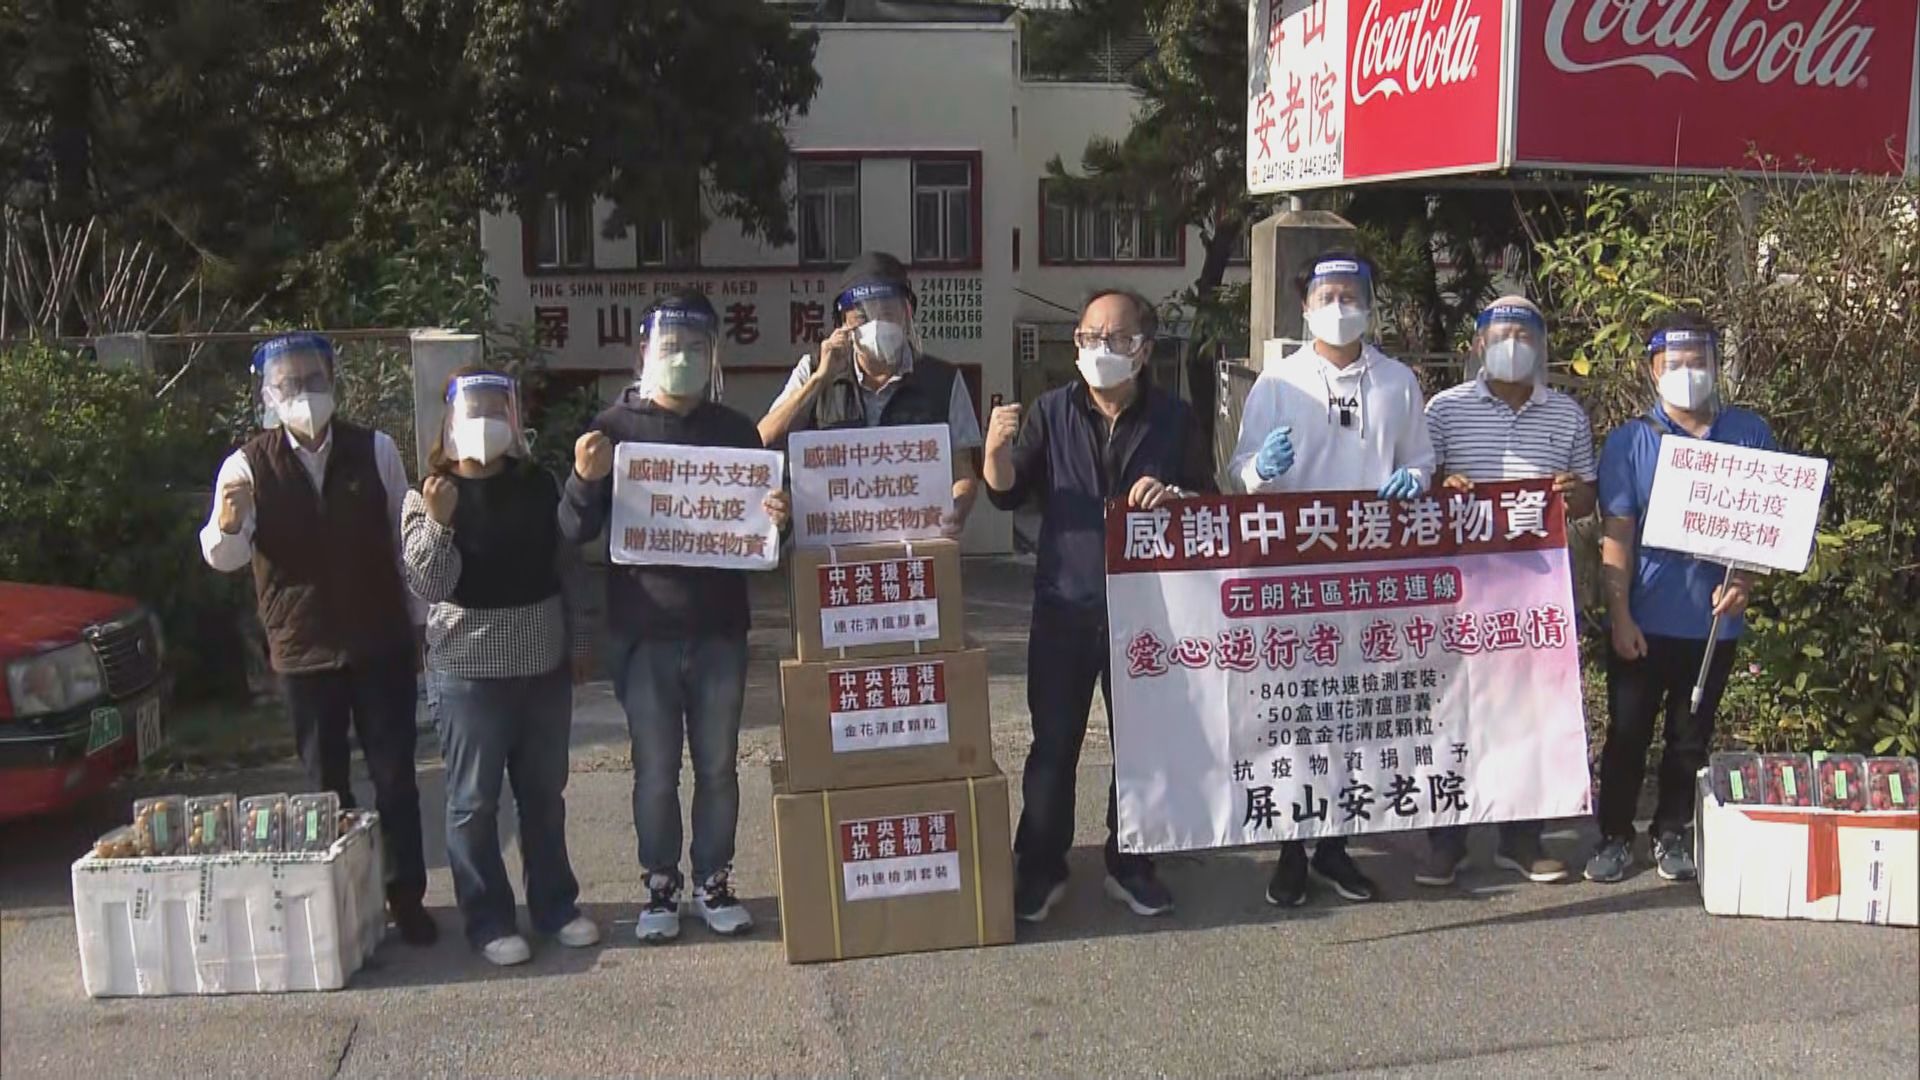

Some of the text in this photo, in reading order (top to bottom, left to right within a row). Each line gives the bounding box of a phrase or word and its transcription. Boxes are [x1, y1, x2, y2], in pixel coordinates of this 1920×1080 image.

[1253, 61, 1338, 160] 安老院
[530, 282, 562, 298] PING
[569, 281, 603, 297] SHAN
[610, 281, 646, 296] HOME
[722, 280, 757, 295] AGED
[921, 278, 983, 292] 24471945
[921, 294, 983, 308] 24451758
[921, 310, 983, 323] 24864366
[921, 326, 983, 339] 24480438
[803, 438, 941, 469] 感謝中央支援
[627, 458, 771, 488] 感謝中央支援
[1671, 447, 1818, 491] 感謝中央支援
[828, 473, 919, 501] 同心抗疫
[1689, 480, 1788, 518] 同心抗疫
[651, 493, 746, 521] 同心抗疫
[806, 505, 943, 536] 贈送防疫物資
[1124, 489, 1549, 560] 感謝中央援港物資
[1682, 510, 1781, 547] 戰勝疫情
[624, 526, 768, 557] 贈送防疫物資
[829, 559, 925, 587] 中央援港
[829, 579, 926, 606] 抗疫物資
[1229, 572, 1457, 612] 元朗社區抗疫連線
[1127, 604, 1569, 677] 愛心逆行者 疫中送溫情
[839, 664, 935, 690] 中央援港
[839, 684, 937, 710] 抗疫物資
[1233, 742, 1469, 781] 抗疫物資捐贈予
[1242, 770, 1470, 830] 屏山安老院
[851, 815, 946, 842] 中央援港
[852, 834, 948, 860] 抗疫物資
